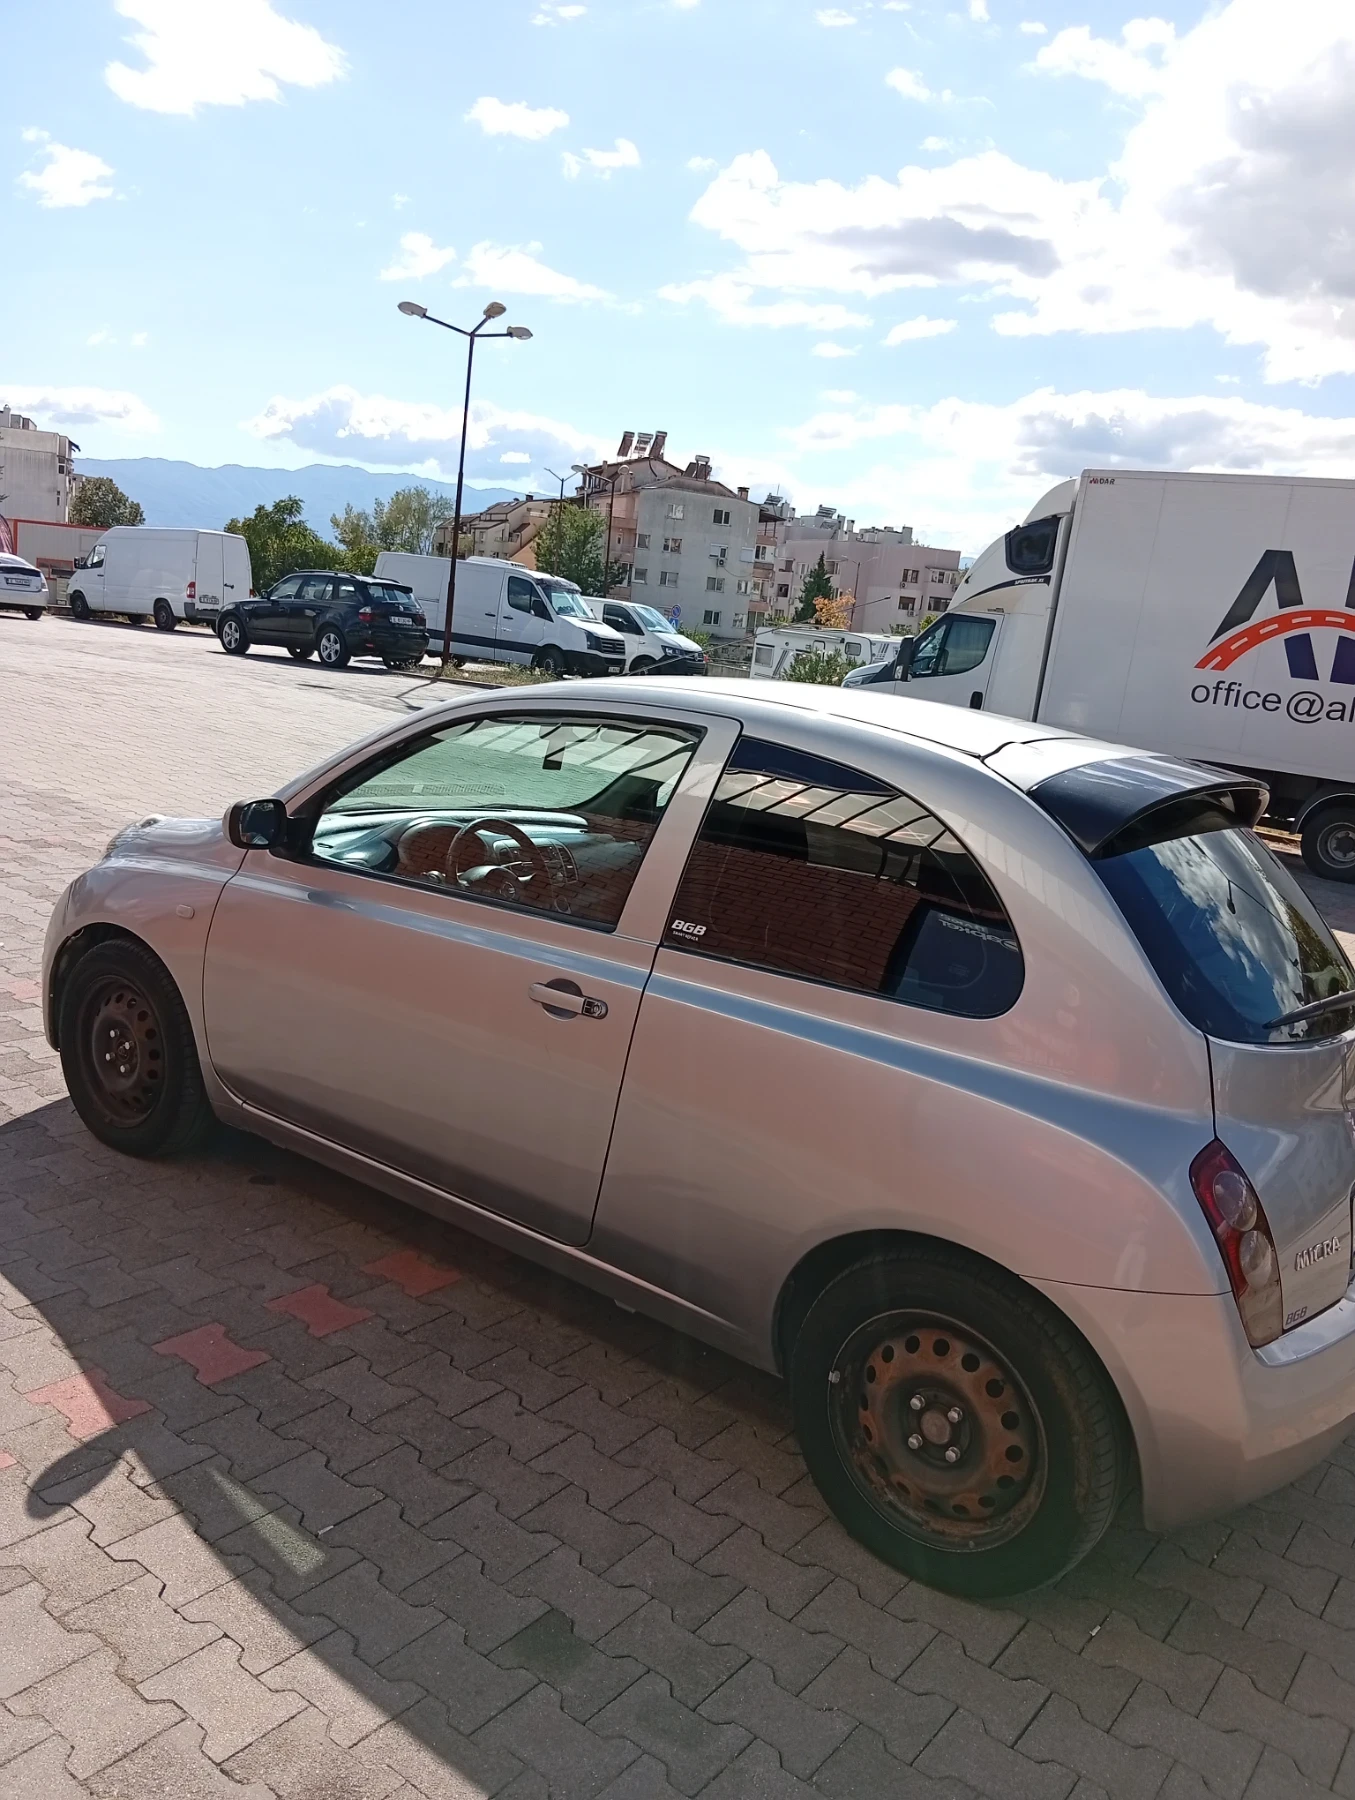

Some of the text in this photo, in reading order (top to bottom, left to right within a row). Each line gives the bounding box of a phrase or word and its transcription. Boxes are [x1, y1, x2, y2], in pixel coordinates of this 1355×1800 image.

[671, 919, 707, 936] BGB
[1294, 1236, 1342, 1271] MICRA
[1285, 1306, 1308, 1326] BGB
